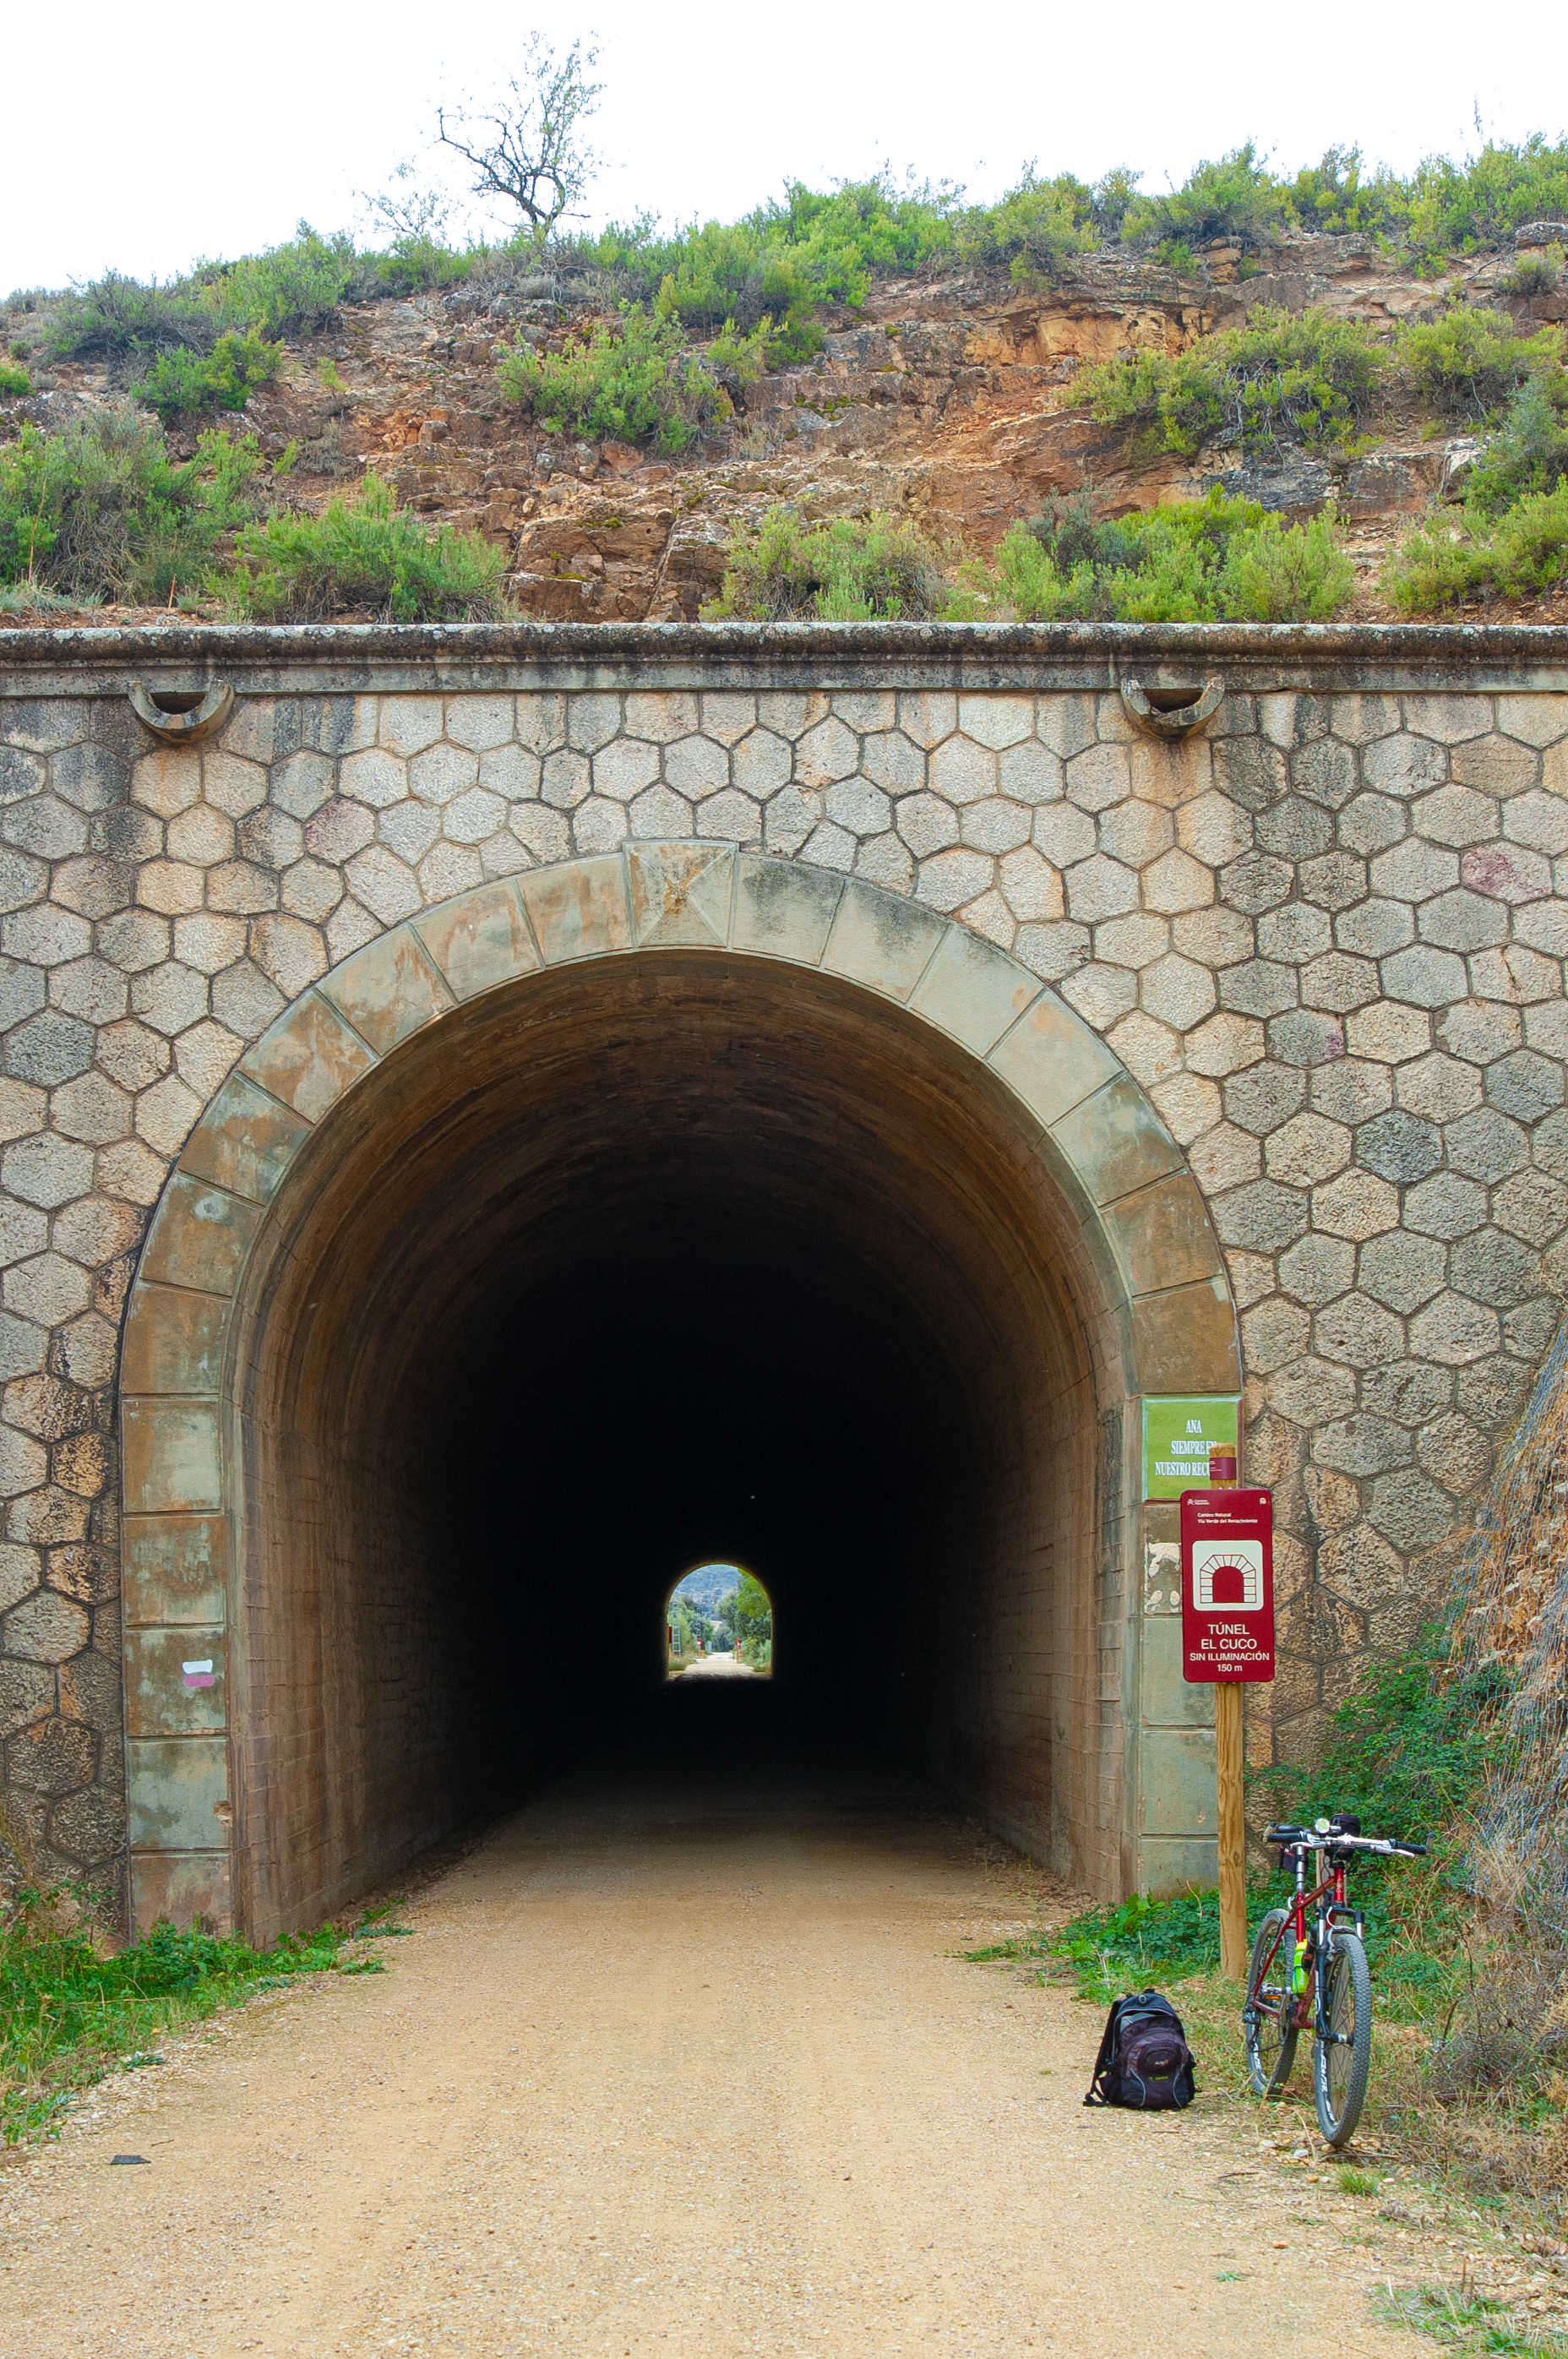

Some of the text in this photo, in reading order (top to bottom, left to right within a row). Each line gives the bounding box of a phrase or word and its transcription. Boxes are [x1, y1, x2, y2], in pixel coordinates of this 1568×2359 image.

[1185, 1419, 1202, 1434] ANA
[1171, 1440, 1205, 1455] SIEMPRE
[1155, 1462, 1211, 1476] NUESTRO RECU
[1206, 1621, 1250, 1635] TÚNEL
[1200, 1638, 1257, 1650] EL CUCO
[1190, 1650, 1270, 1661] SIN ILUMINACIÓN
[1217, 1664, 1233, 1672] 150
